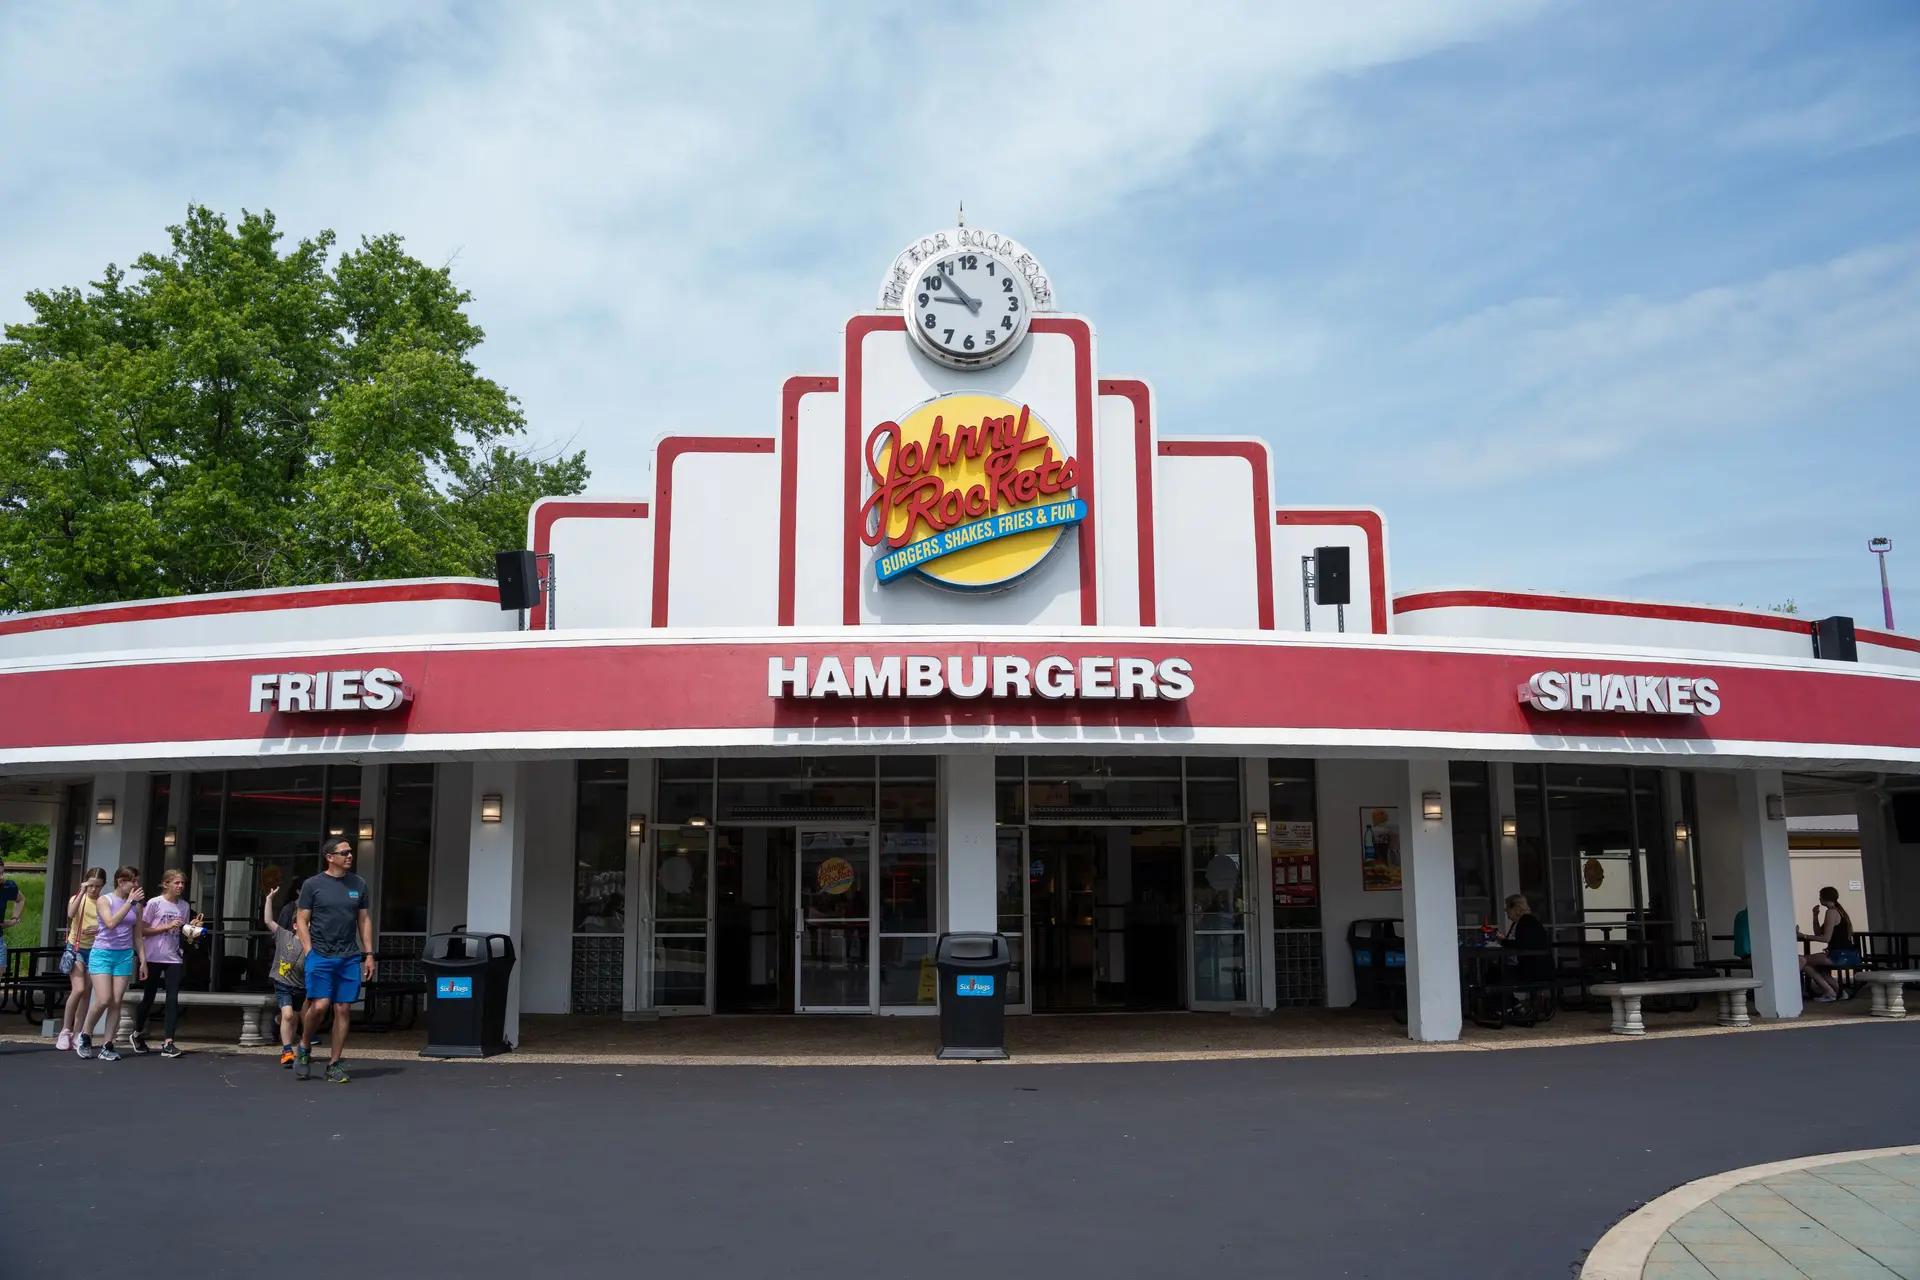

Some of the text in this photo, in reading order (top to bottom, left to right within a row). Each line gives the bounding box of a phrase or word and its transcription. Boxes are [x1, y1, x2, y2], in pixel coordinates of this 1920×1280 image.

[937, 261, 954, 276] 11
[958, 255, 977, 270] 12
[986, 262, 995, 276] 1
[923, 276, 942, 291] 10
[1002, 278, 1013, 292] 2
[918, 293, 930, 308] 9
[1008, 296, 1019, 312] 3
[925, 314, 936, 329] 8
[1001, 315, 1013, 330] 4
[943, 329, 955, 344] 7
[963, 335, 975, 350] 6
[985, 330, 996, 345] 5
[859, 404, 1050, 547] Johnny
[888, 447, 1080, 548] Rockets
[882, 503, 1076, 576] BURGERS, SHAKES, FRIES & FUN
[767, 654, 1195, 700] HAMBURGERS
[249, 667, 402, 713] FRIES
[1532, 669, 1720, 716] SHAKES
